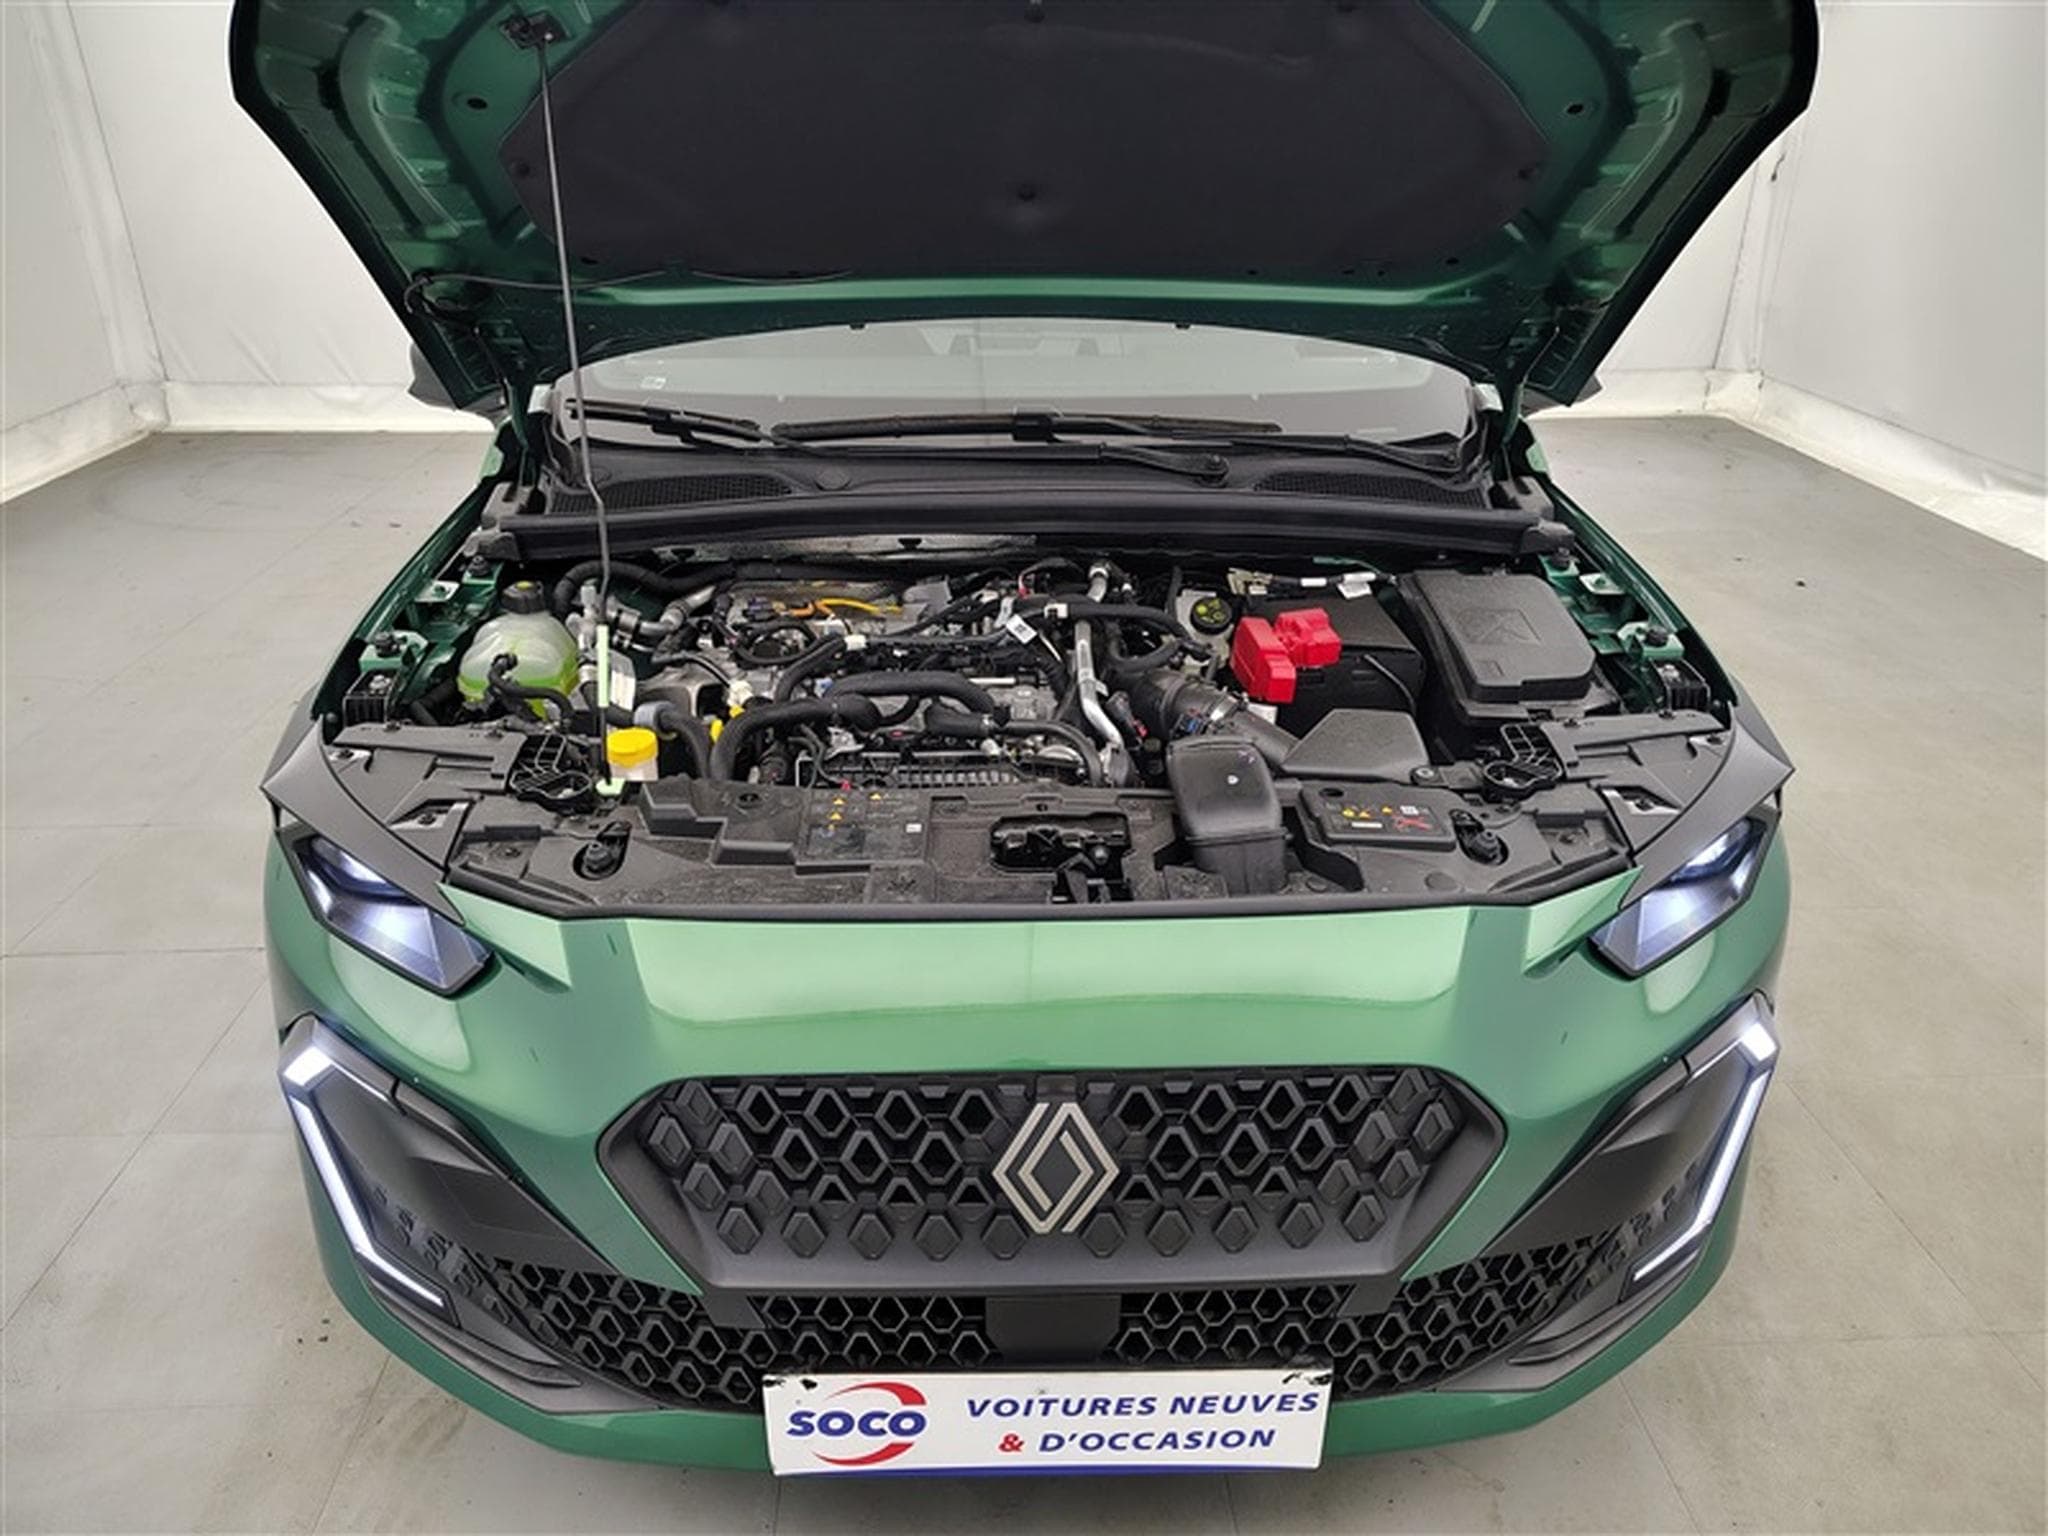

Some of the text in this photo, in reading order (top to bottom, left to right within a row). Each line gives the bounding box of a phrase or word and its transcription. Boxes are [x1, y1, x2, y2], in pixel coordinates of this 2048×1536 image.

[967, 1392, 1319, 1418] VOITURES NEUVES
[787, 1410, 927, 1437] SOCO
[997, 1429, 1275, 1453] & D'OCCASION
